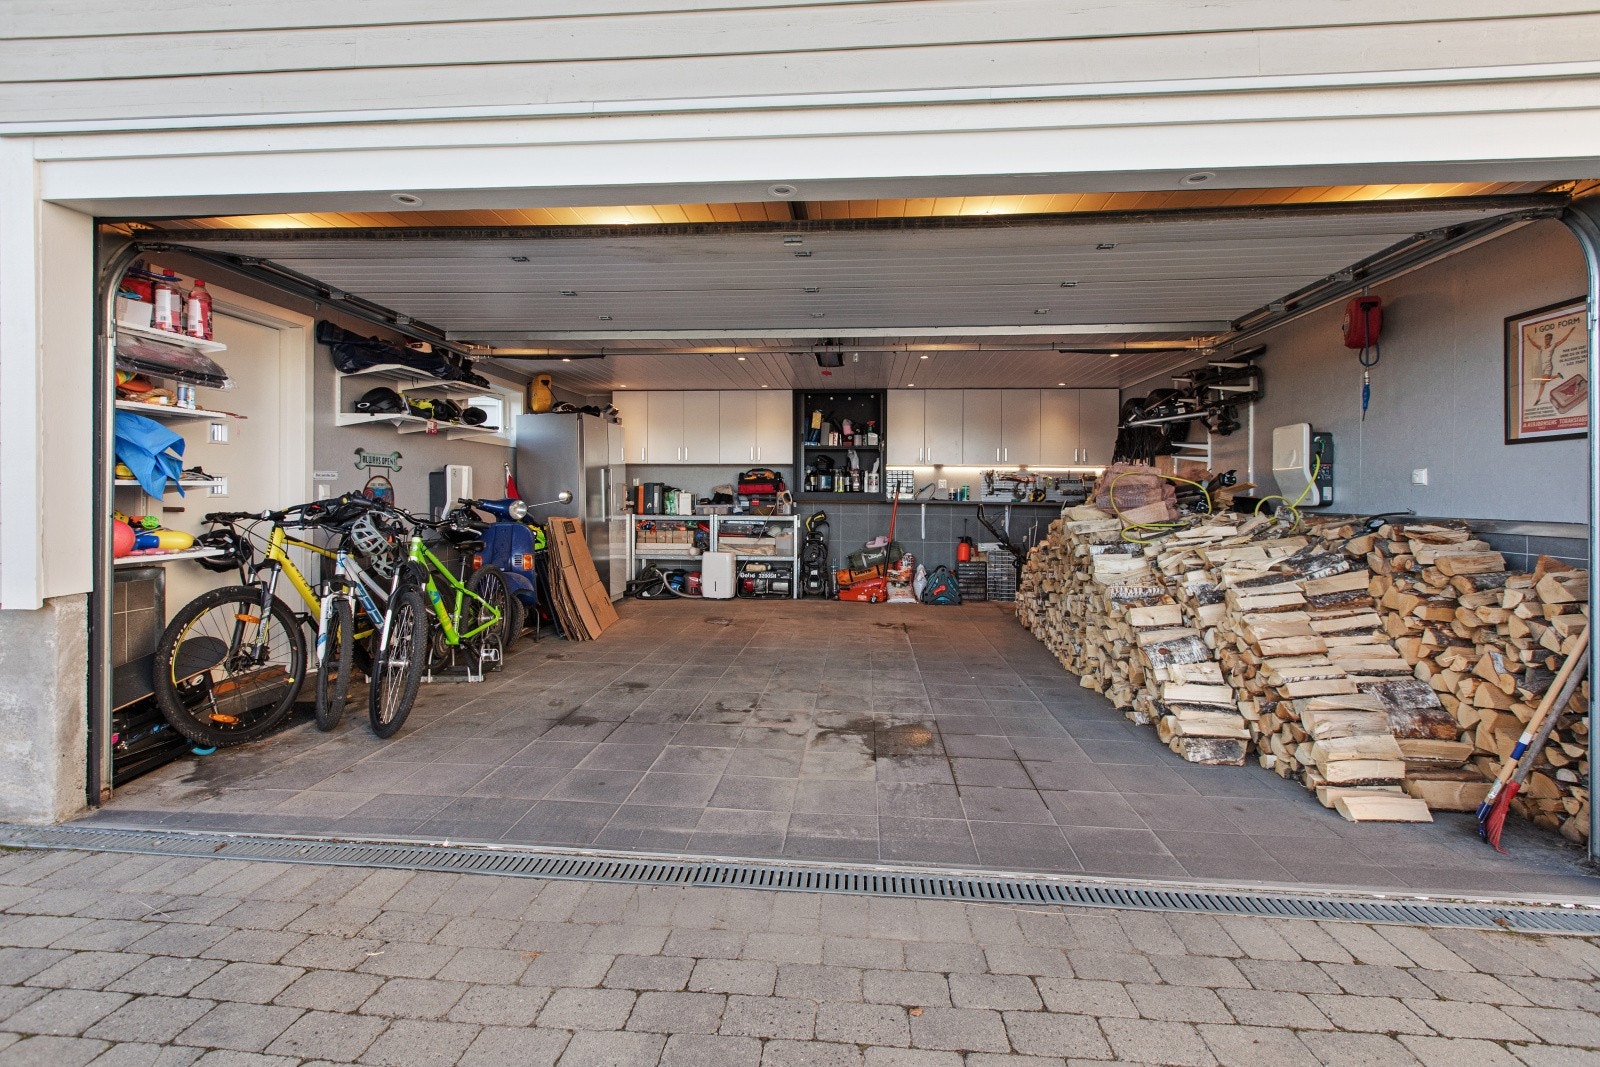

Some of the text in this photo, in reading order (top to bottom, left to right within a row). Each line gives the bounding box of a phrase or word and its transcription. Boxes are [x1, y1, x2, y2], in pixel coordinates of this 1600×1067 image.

[1539, 323, 1555, 332] GOD
[1558, 317, 1580, 328] FORM
[362, 455, 381, 464] ALWAYS
